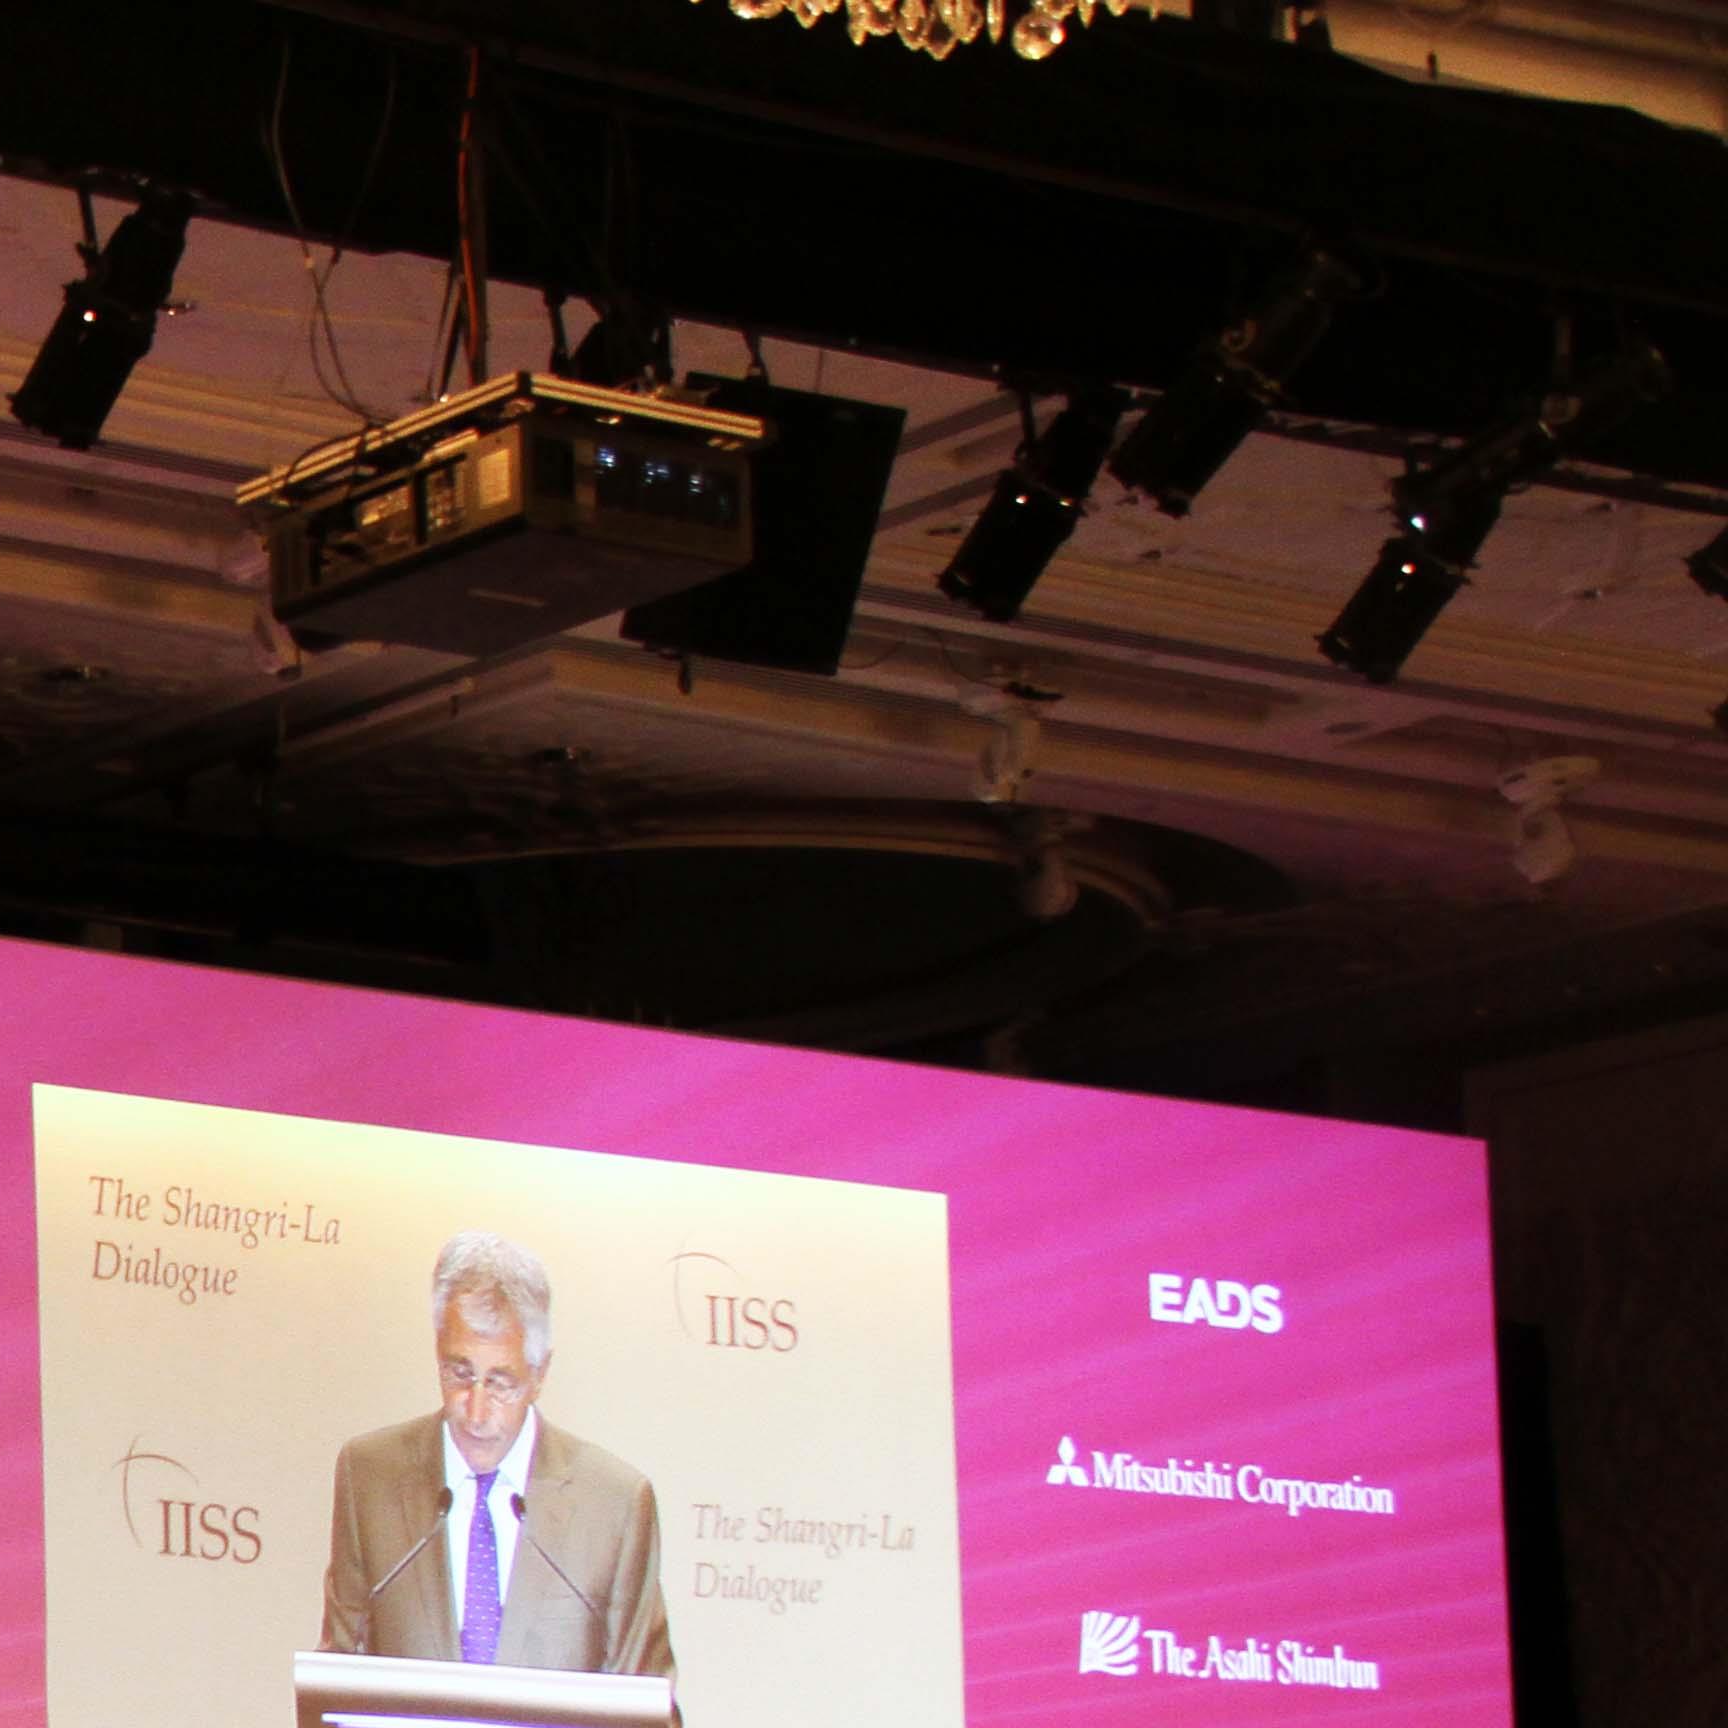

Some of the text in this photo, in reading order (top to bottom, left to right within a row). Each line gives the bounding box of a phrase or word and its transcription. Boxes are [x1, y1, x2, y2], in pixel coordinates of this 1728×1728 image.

[89, 1175, 342, 1253] The Shangri-La
[90, 1241, 240, 1305] Dialogue
[1148, 1272, 1285, 1334] EADS
[704, 1293, 800, 1353] IISS
[1091, 1450, 1394, 1518] Mitsubishi Corporation
[157, 1499, 264, 1565] IISS
[692, 1503, 915, 1558] The Shangri-La
[692, 1562, 824, 1615] Dialogue
[1143, 1629, 1196, 1677] The
[1198, 1635, 1273, 1682] Asahi
